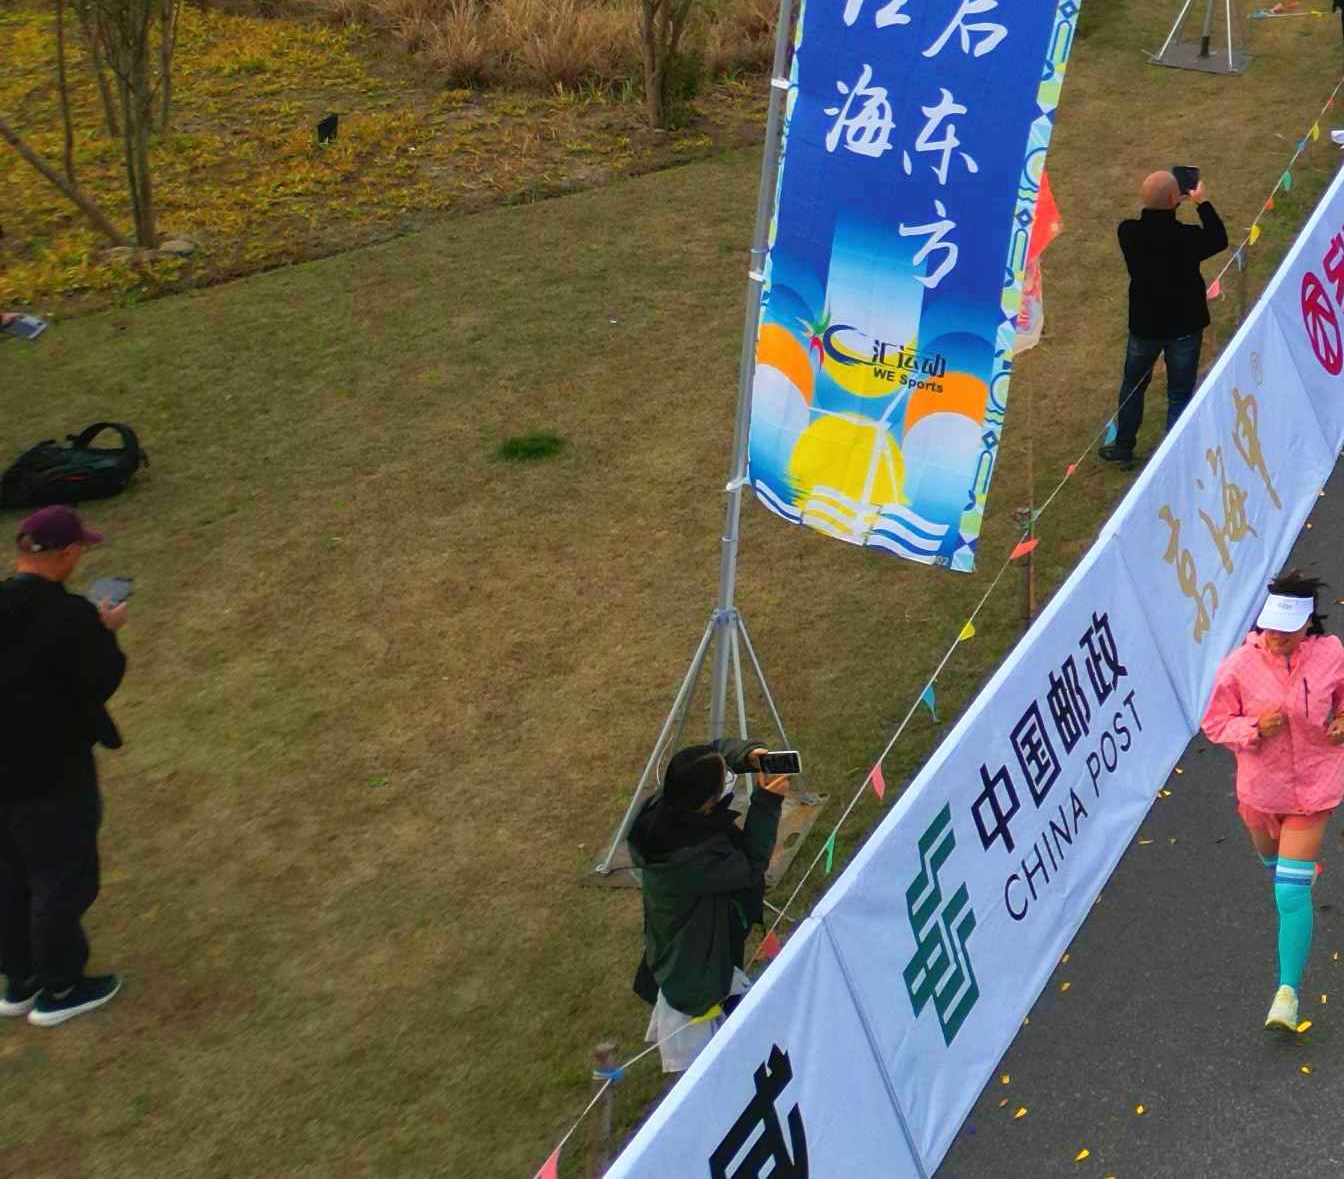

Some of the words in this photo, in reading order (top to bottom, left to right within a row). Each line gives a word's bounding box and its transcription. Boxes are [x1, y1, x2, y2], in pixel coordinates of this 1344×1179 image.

[872, 367, 895, 382] WE
[899, 374, 944, 394] Sports
[970, 610, 1129, 855] 中国邮政
[1004, 786, 1089, 922] CHINA
[1085, 689, 1143, 799] POST
